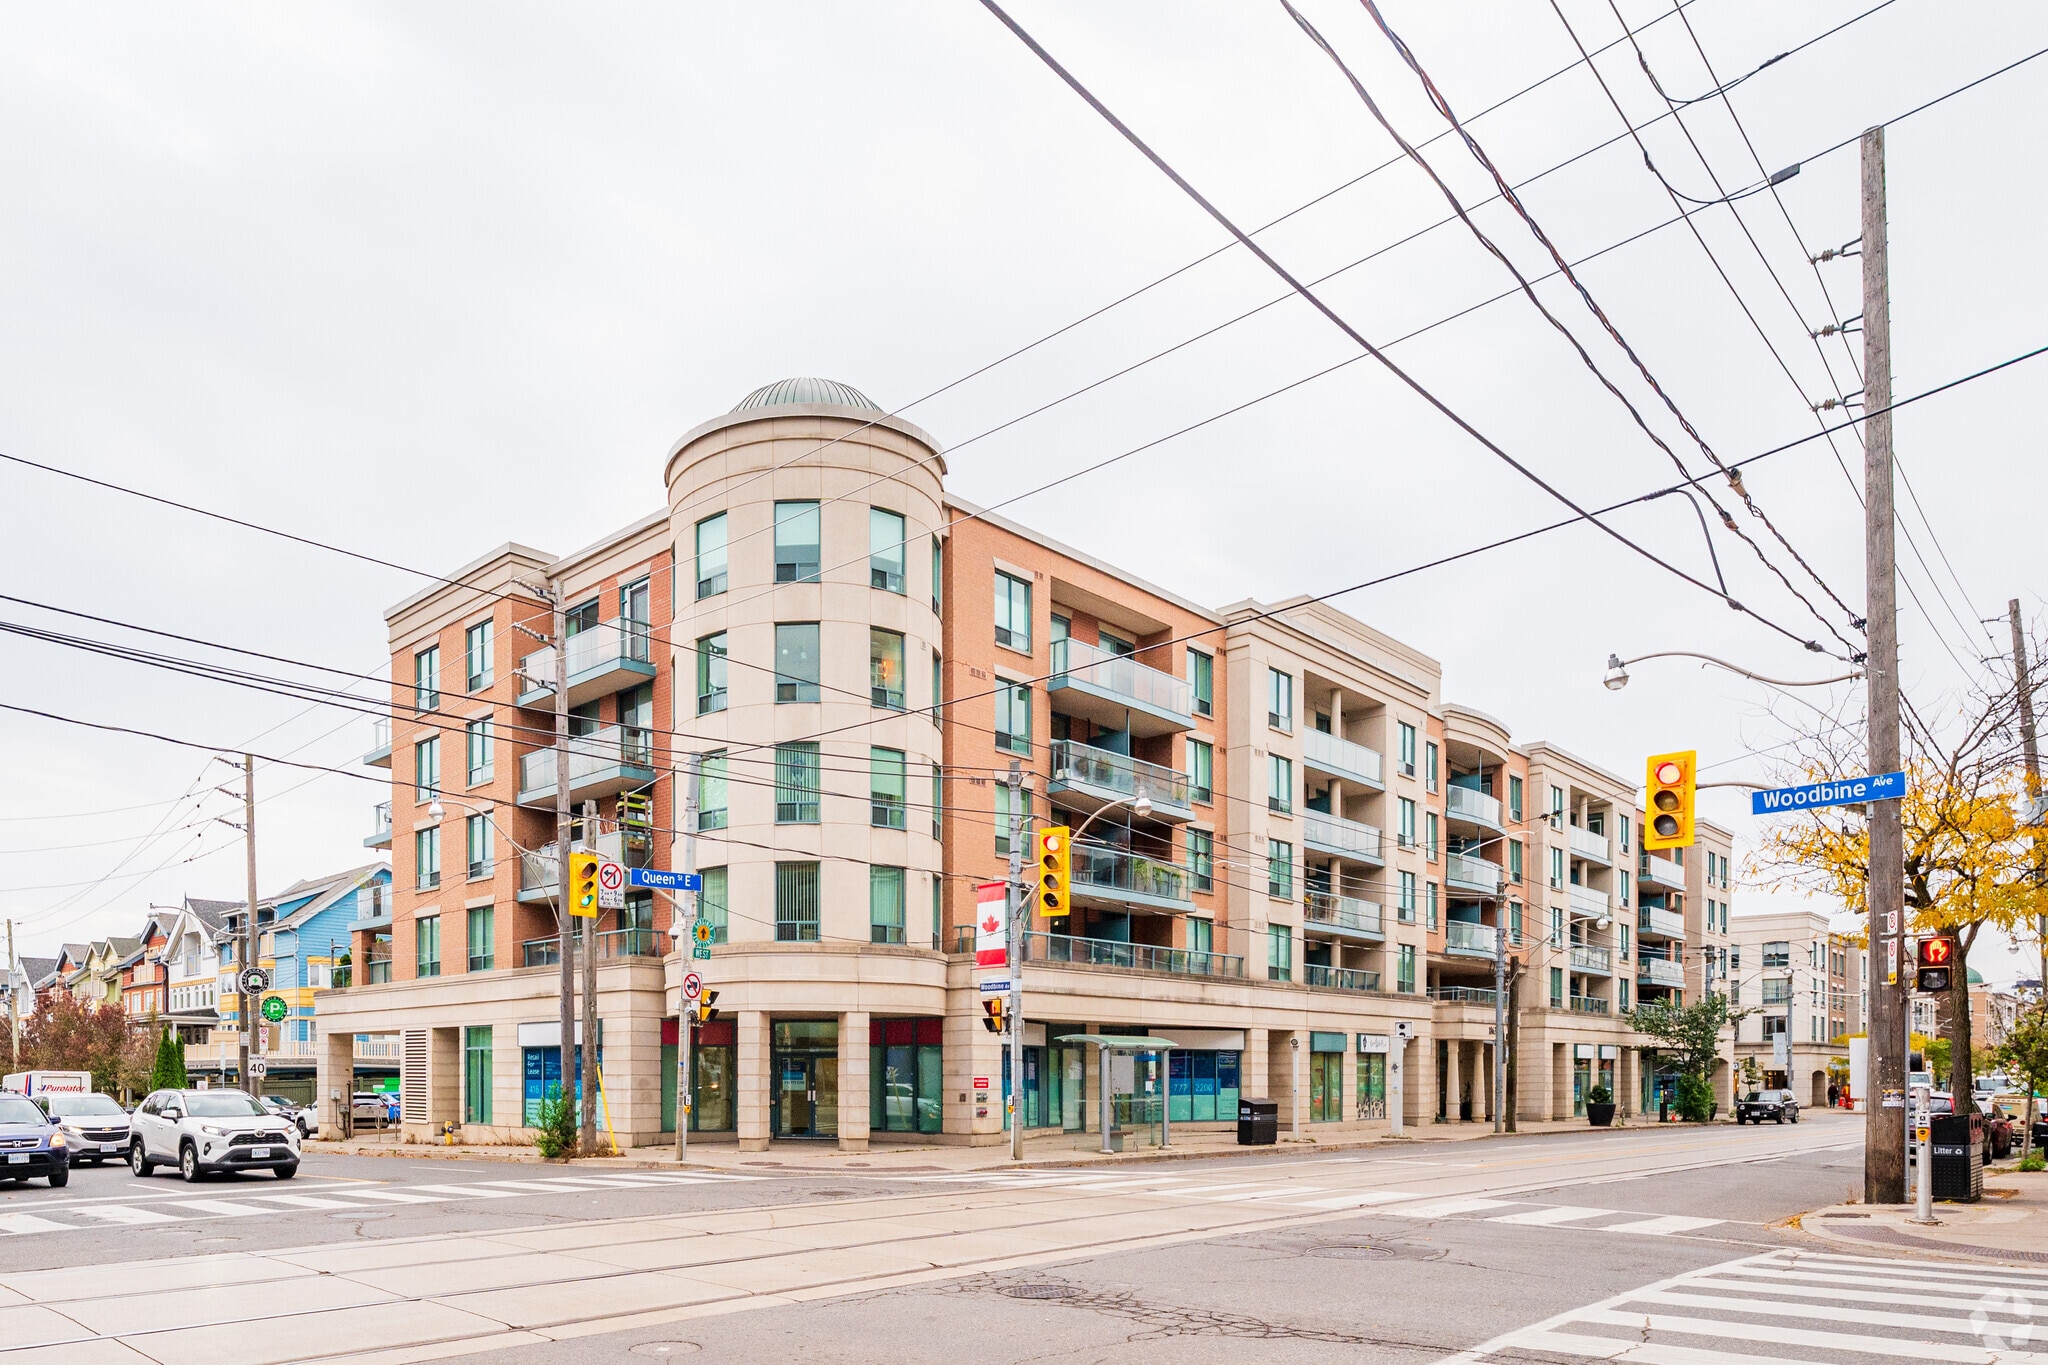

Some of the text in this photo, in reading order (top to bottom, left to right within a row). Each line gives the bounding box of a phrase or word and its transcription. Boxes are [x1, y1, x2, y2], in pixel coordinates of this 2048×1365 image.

[1763, 777, 1893, 808] Woodbine Ave
[641, 871, 675, 886] Queen
[684, 875, 691, 887] E
[695, 949, 710, 959] WEST
[269, 1002, 281, 1014] P
[527, 1053, 540, 1061] Retail
[250, 1063, 265, 1073] 40
[45, 1085, 85, 1093] Purolator
[529, 1085, 540, 1094] 416
[1173, 1084, 1213, 1092] 777 2200
